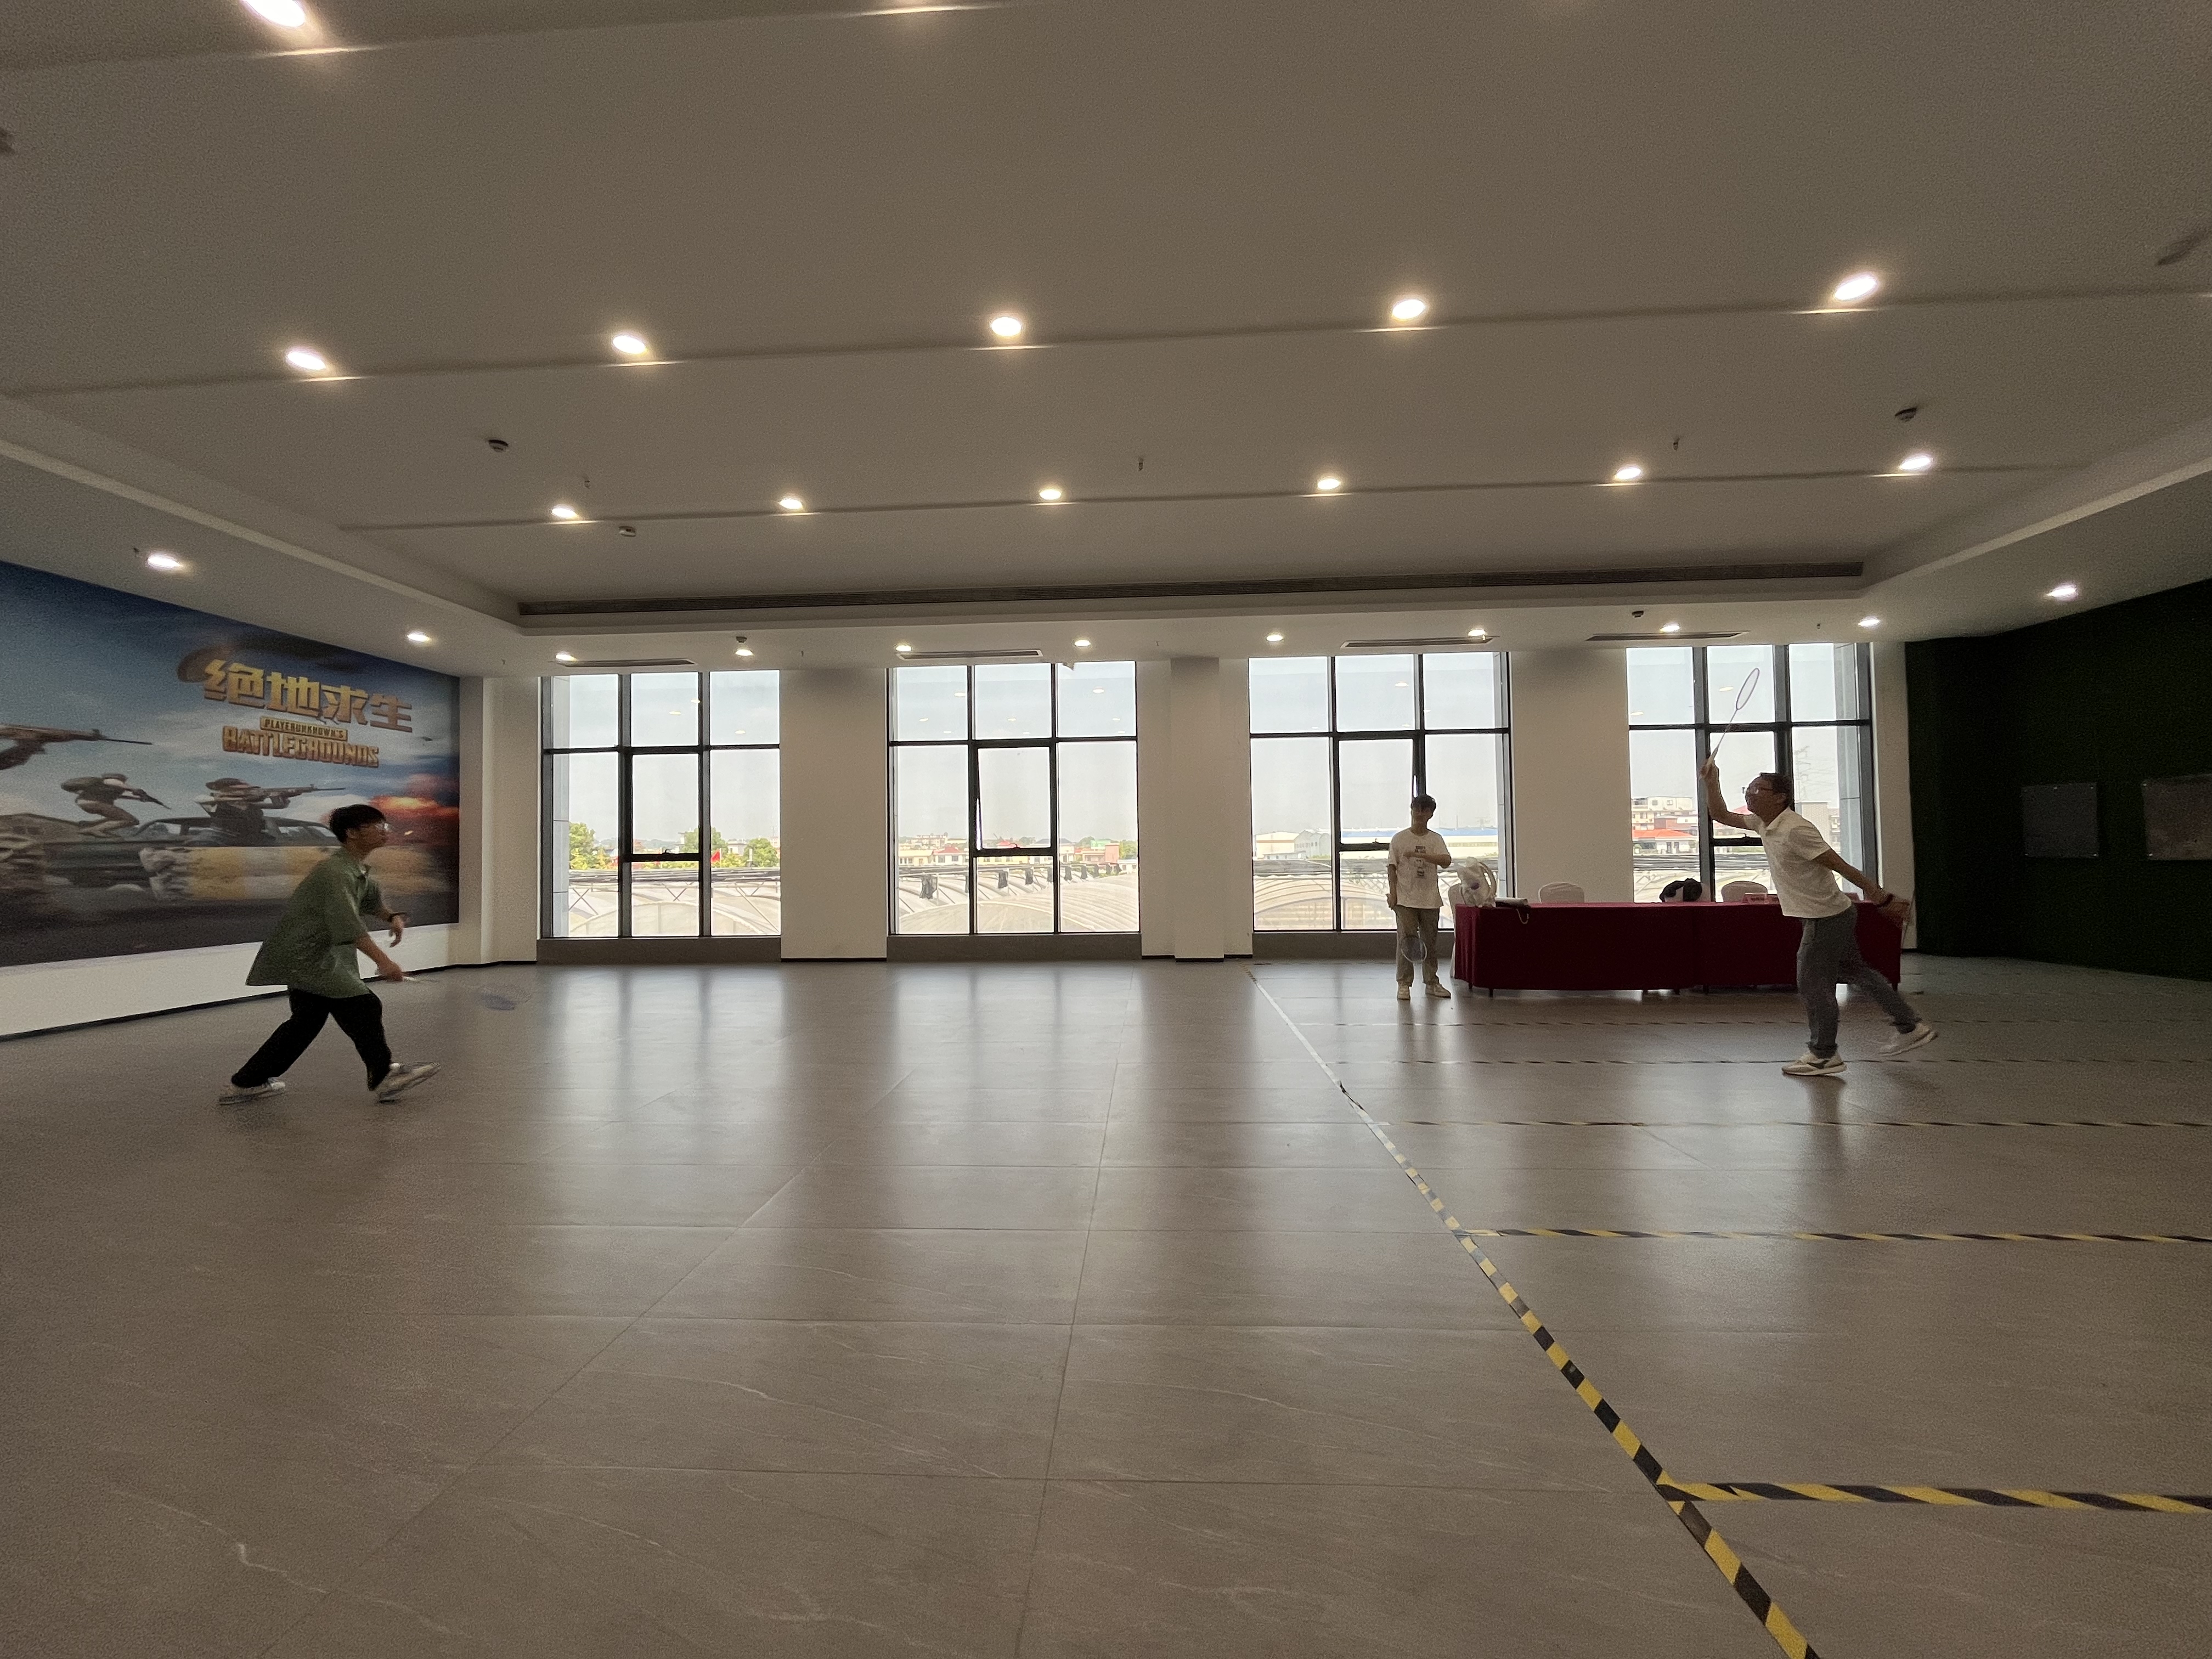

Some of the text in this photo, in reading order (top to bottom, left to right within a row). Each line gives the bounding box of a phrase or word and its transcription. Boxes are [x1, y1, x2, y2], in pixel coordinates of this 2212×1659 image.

[204, 659, 413, 732] 绝地求生
[223, 726, 379, 768] BATTLEGROUNDS
[264, 719, 344, 738] PLAYERUNKNOWN'S
